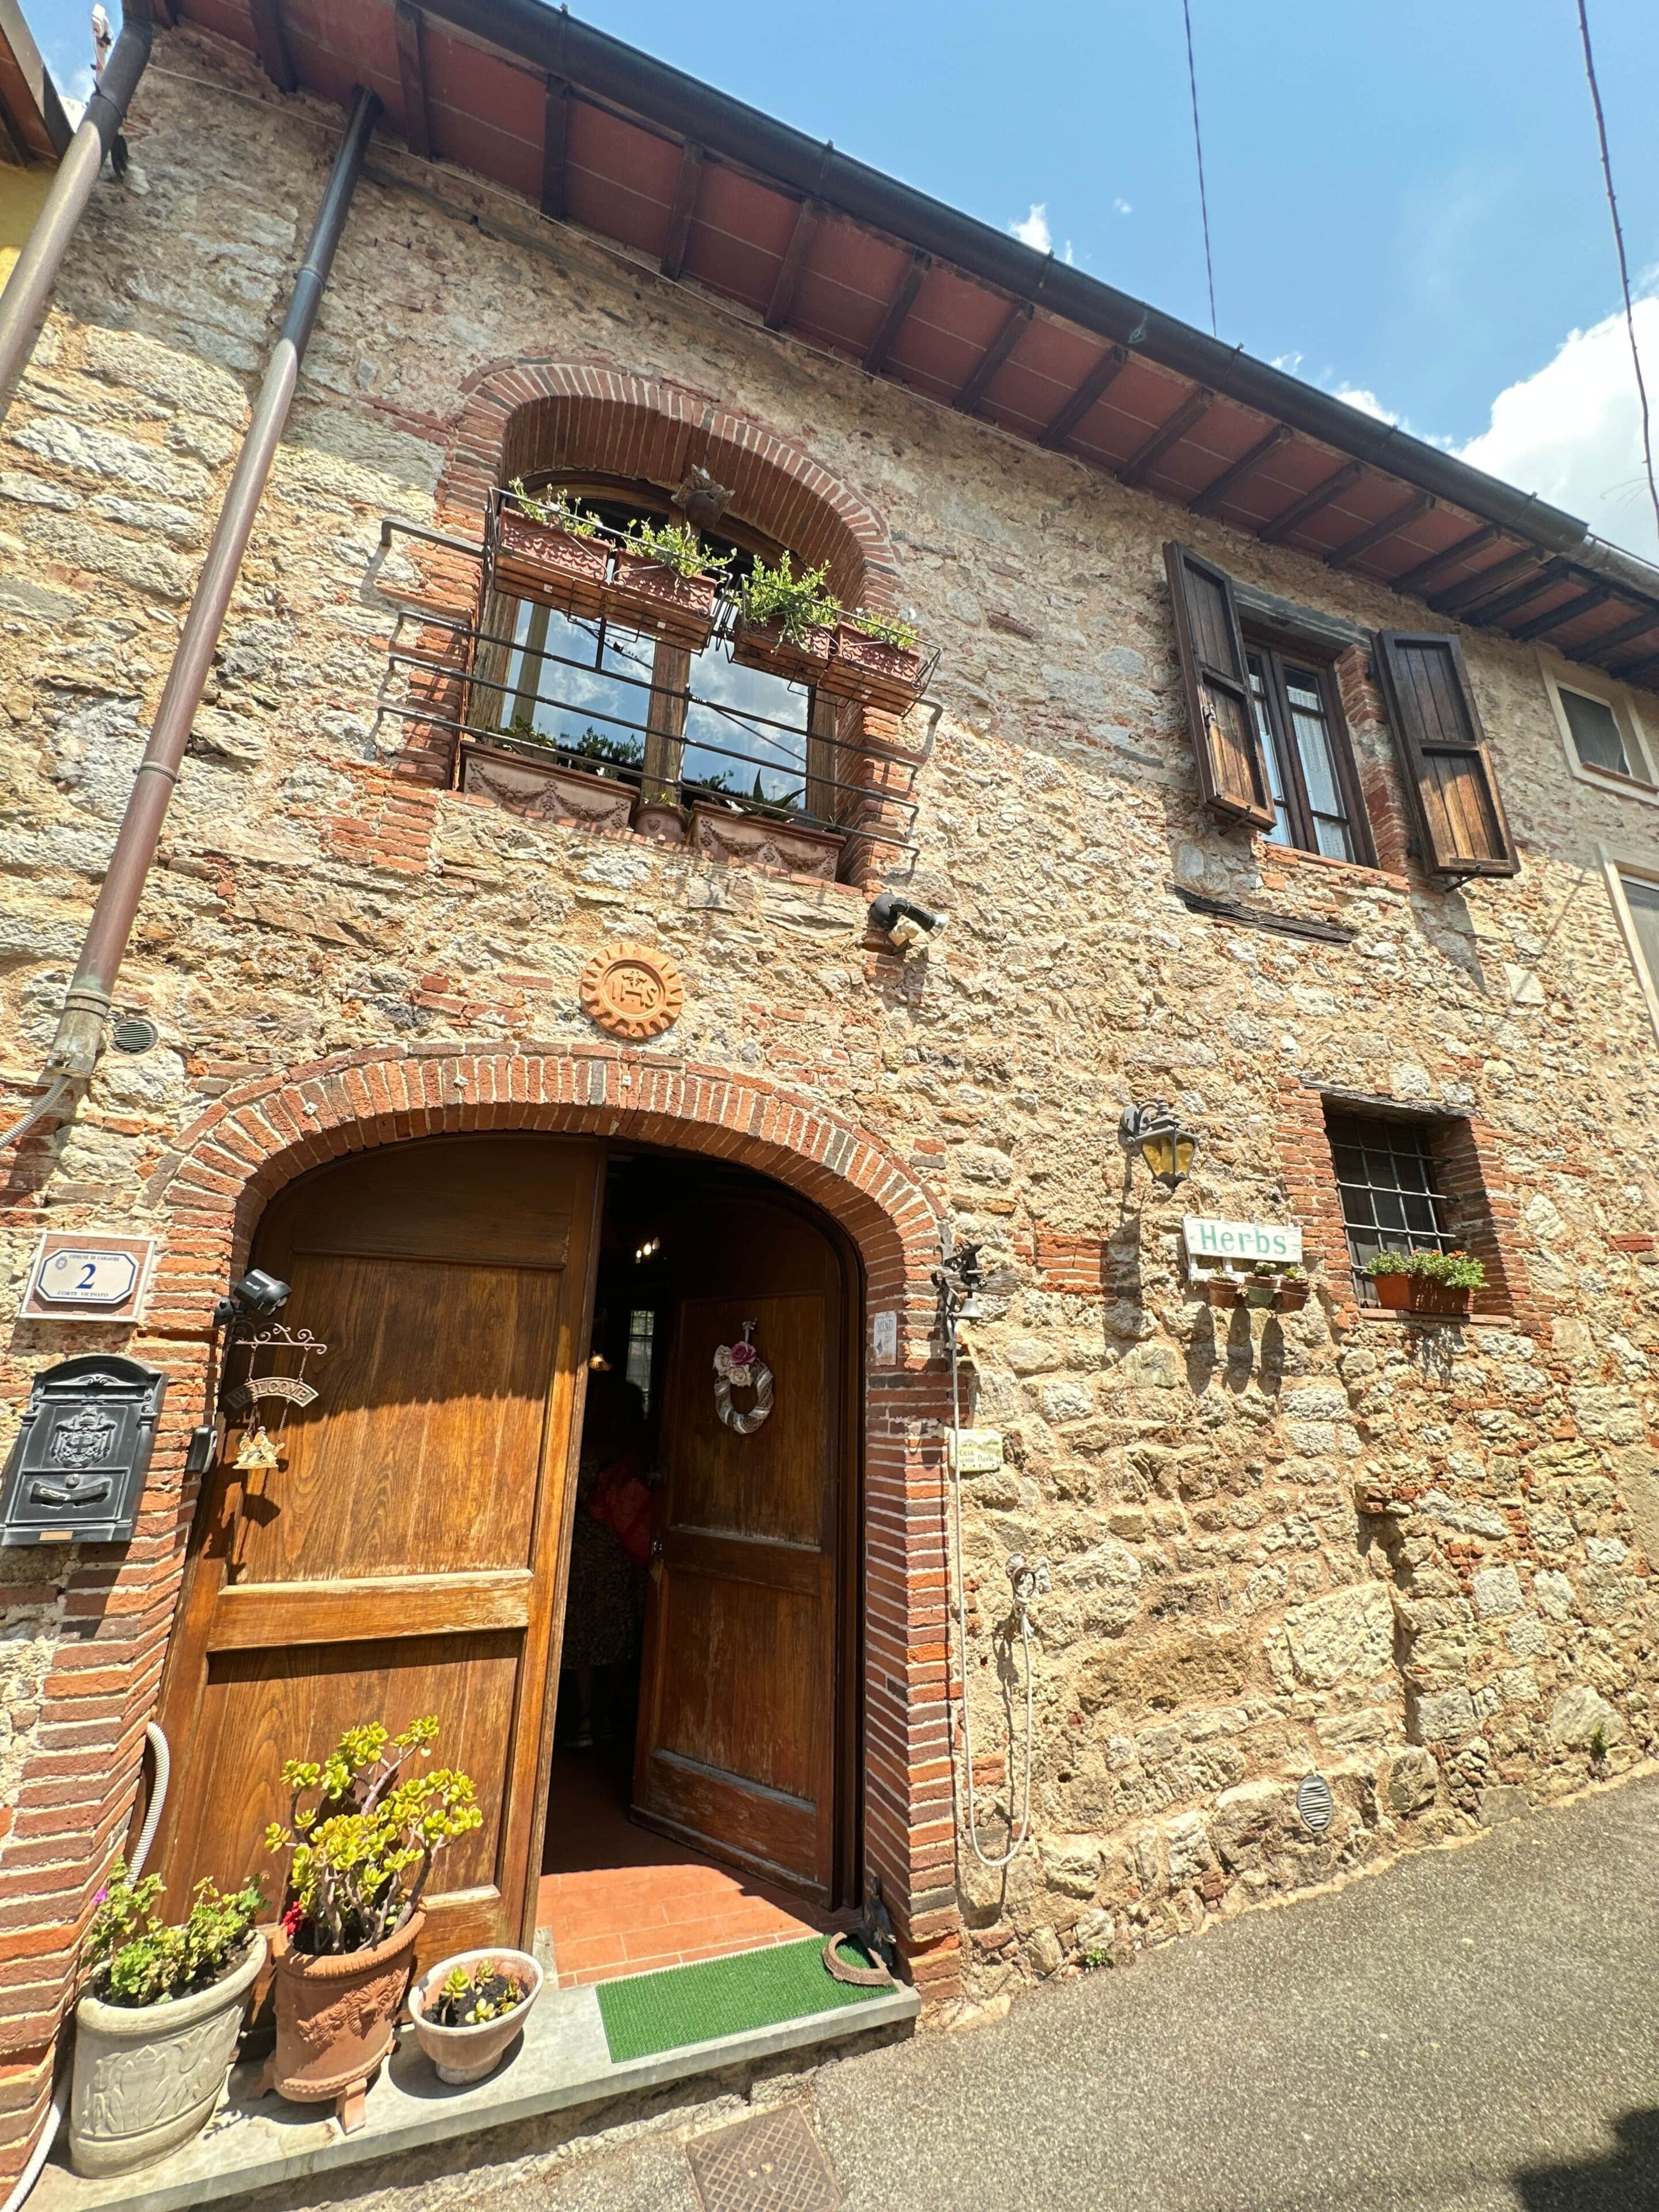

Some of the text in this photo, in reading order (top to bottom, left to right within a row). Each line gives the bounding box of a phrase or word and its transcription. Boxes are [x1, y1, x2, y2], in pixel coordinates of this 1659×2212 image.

[1199, 1224, 1286, 1255] Herbs
[75, 1263, 96, 1289] 2
[232, 1381, 309, 1403] WELCOME
